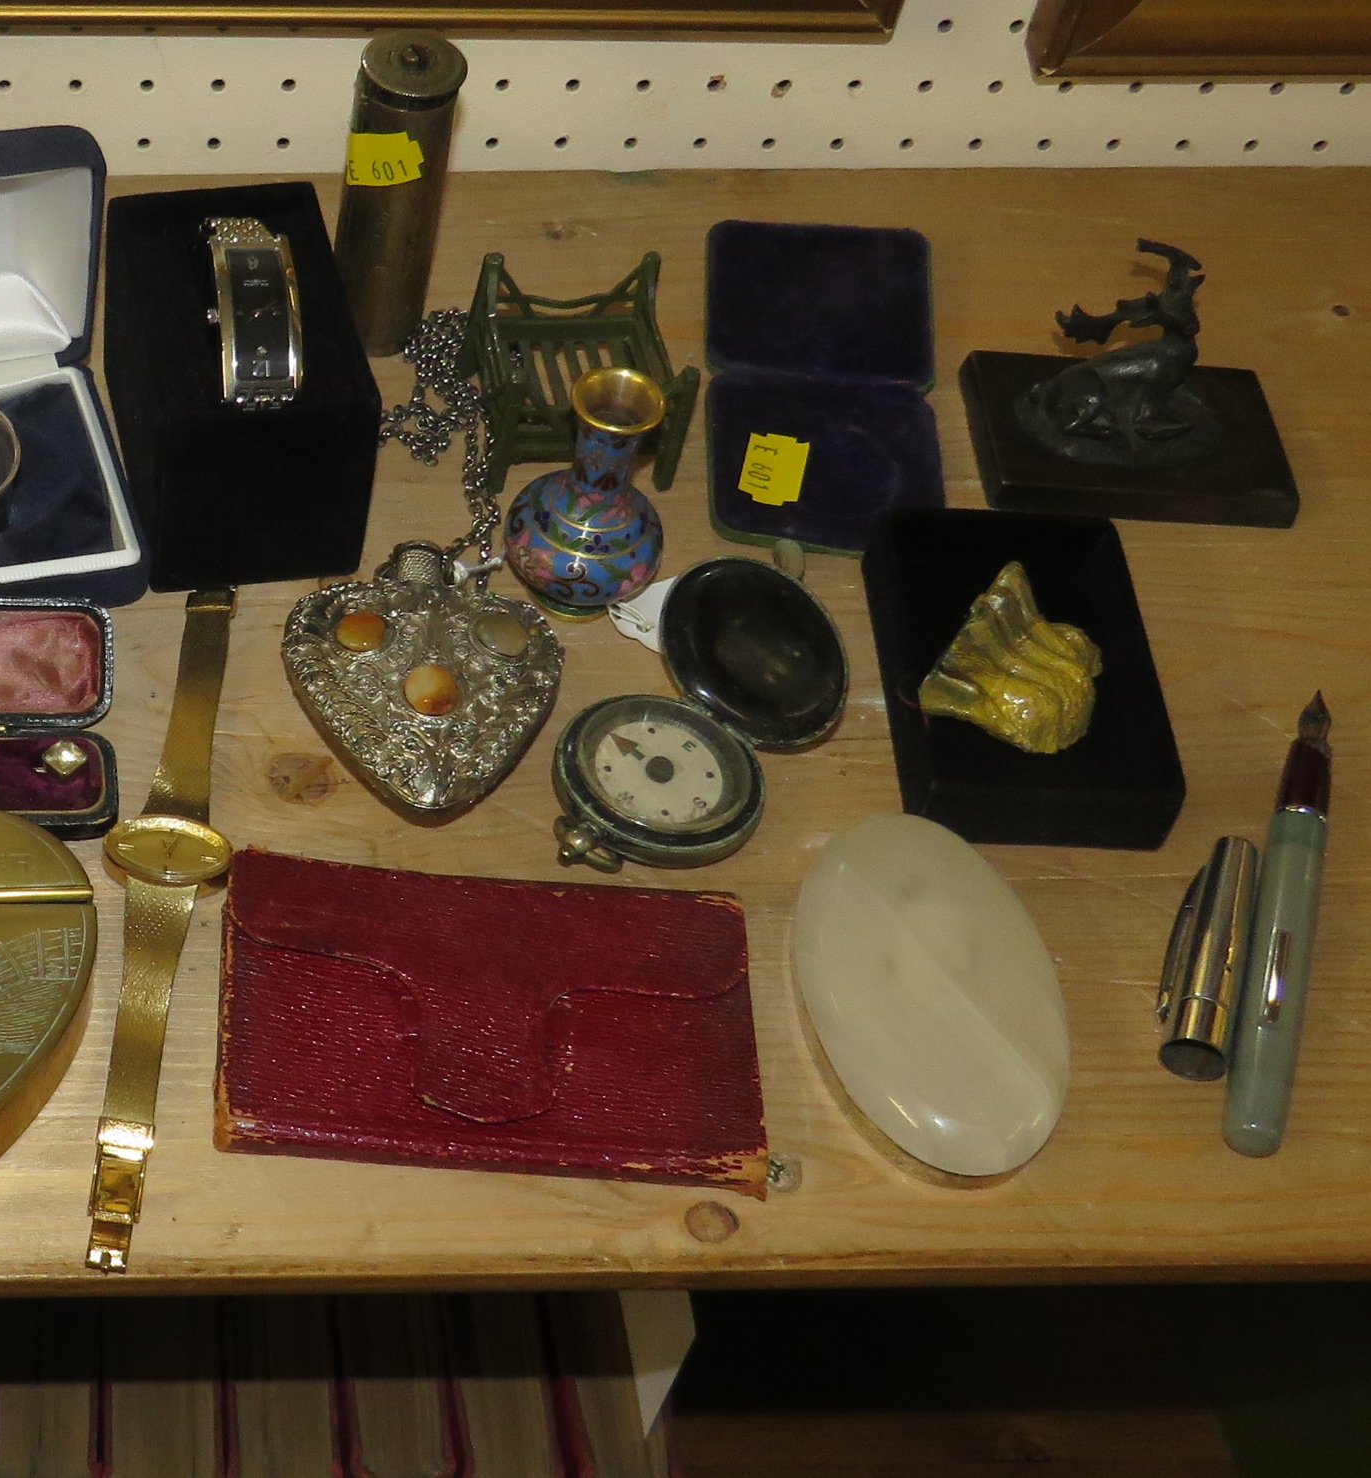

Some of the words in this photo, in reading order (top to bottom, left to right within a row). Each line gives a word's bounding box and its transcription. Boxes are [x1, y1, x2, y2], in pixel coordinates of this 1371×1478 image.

[348, 160, 359, 181] E
[372, 159, 408, 181] 601
[753, 444, 778, 456] E
[746, 462, 773, 491] 601
[681, 740, 697, 753] E
[692, 796, 707, 809] S
